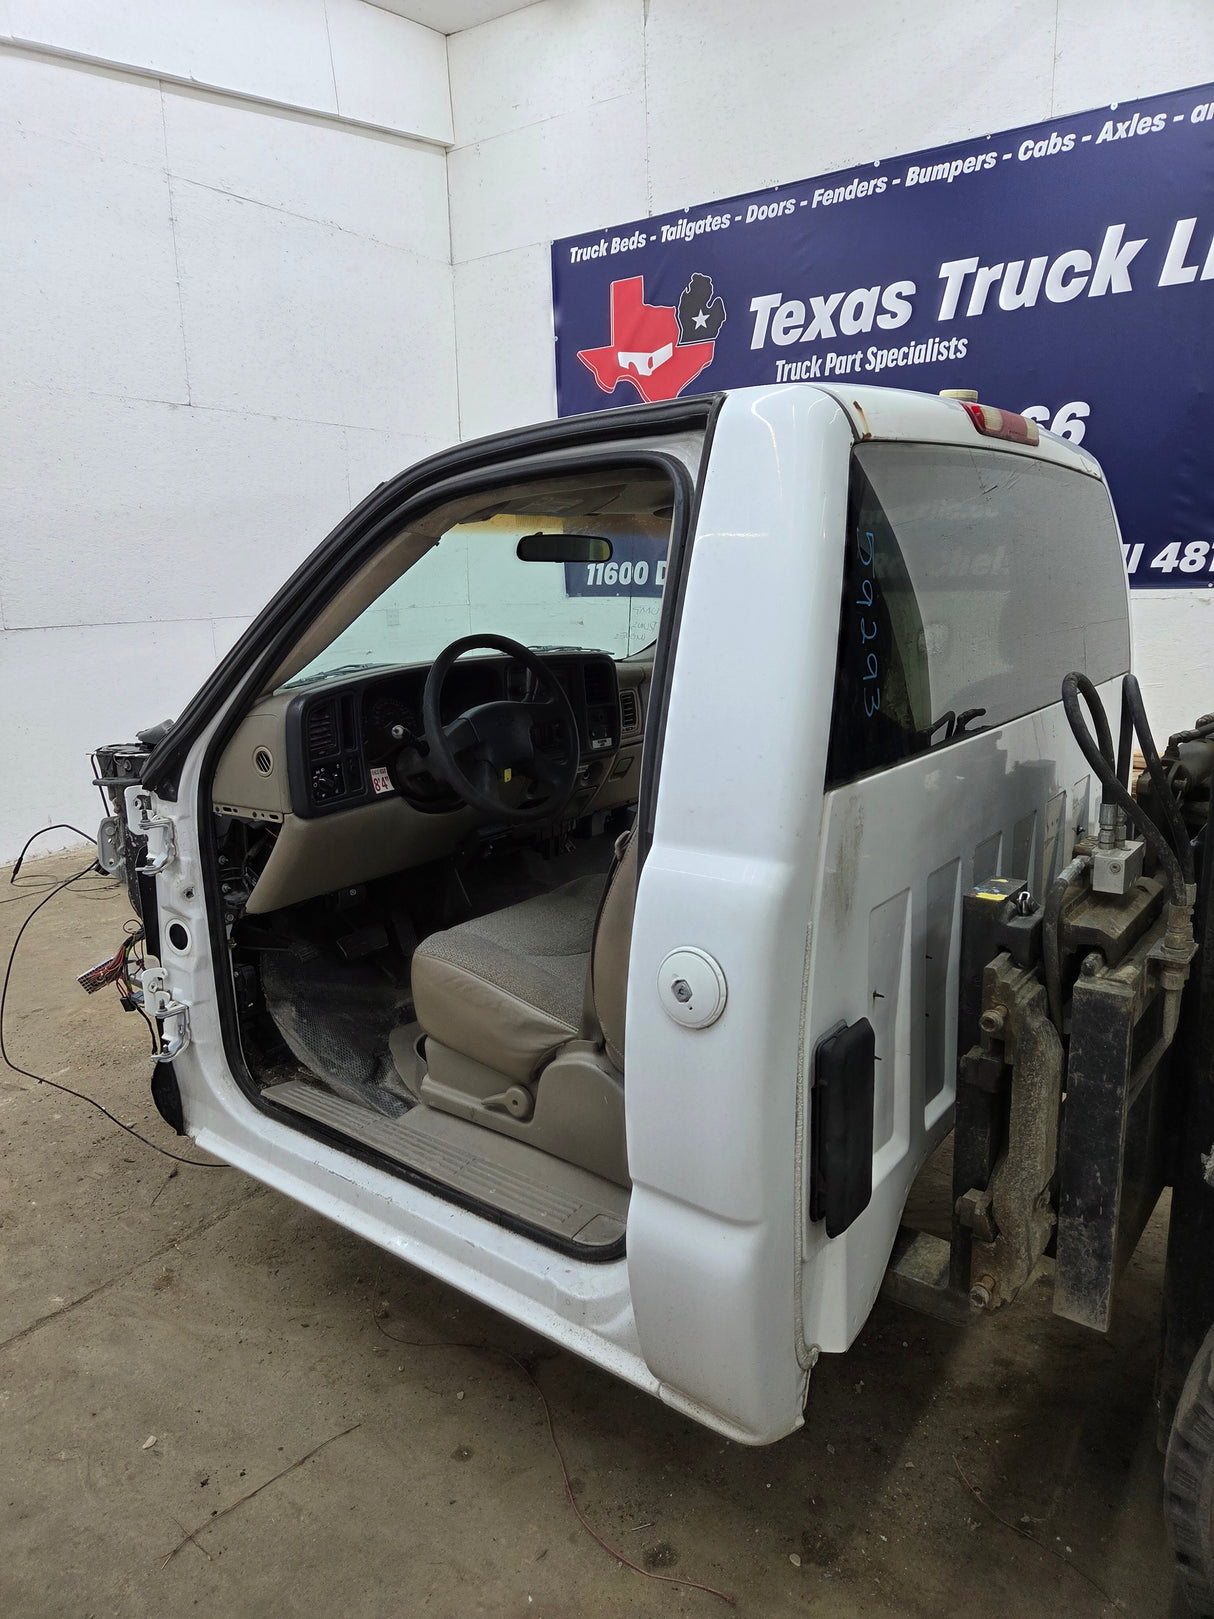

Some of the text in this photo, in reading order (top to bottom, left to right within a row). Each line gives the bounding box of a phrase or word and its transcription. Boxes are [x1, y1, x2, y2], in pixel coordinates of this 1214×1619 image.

[570, 239, 608, 264] Truck
[610, 231, 646, 254] Beds
[661, 213, 731, 243] Tailgates
[746, 198, 795, 224] Doors
[811, 177, 888, 209] Fenders
[905, 151, 997, 187] Bumpers
[1017, 132, 1076, 161] Cabs
[1095, 112, 1167, 145] Axles
[749, 279, 917, 351] Texas
[937, 222, 1149, 323] Truck
[775, 336, 969, 382] Truck Part Specialists
[587, 560, 649, 586] 11600
[856, 527, 881, 718] 59293
